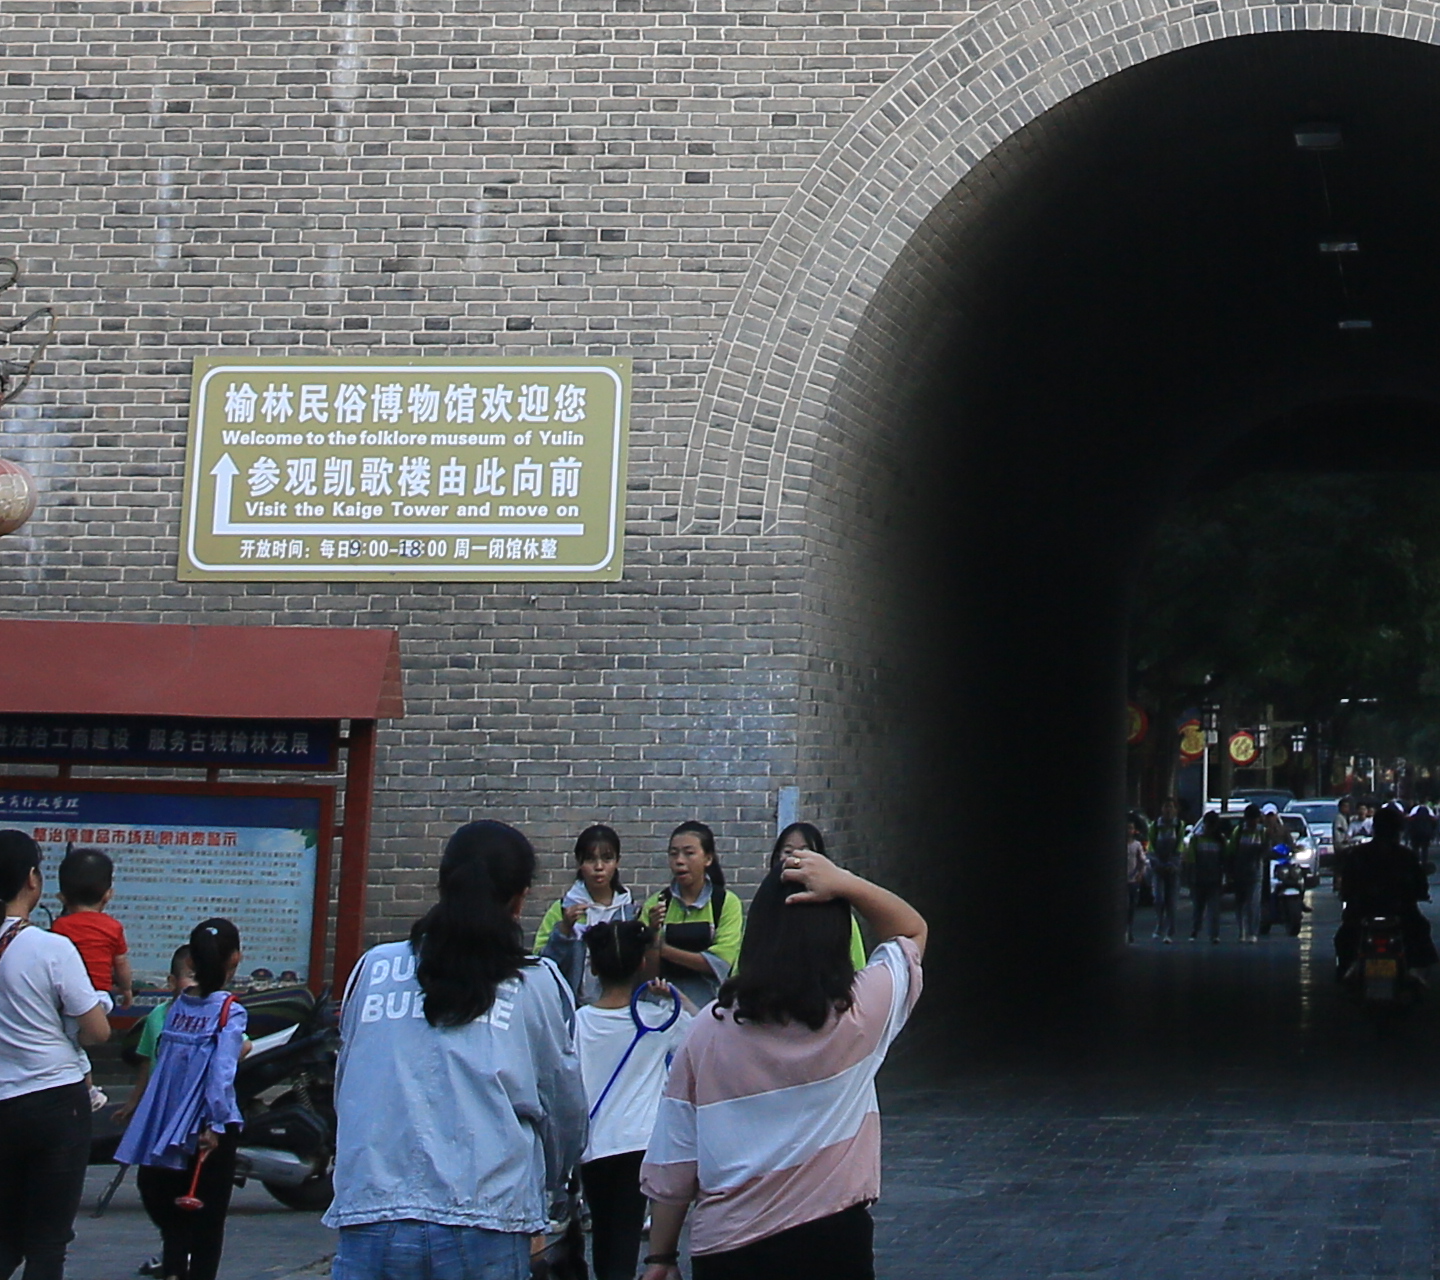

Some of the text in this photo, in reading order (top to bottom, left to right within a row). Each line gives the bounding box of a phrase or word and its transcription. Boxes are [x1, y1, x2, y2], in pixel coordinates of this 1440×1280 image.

[224, 382, 587, 425] 榆林民俗博物馆欢迎您
[222, 430, 585, 447] Welcome to the folklore museum of Yulin
[247, 456, 583, 499] 参观凯歌楼由此向前
[245, 501, 580, 520] Visit the Kaige Tower and move on
[453, 538, 558, 560] 周一闭馆休整
[147, 728, 310, 755] 服务古城榆林发展
